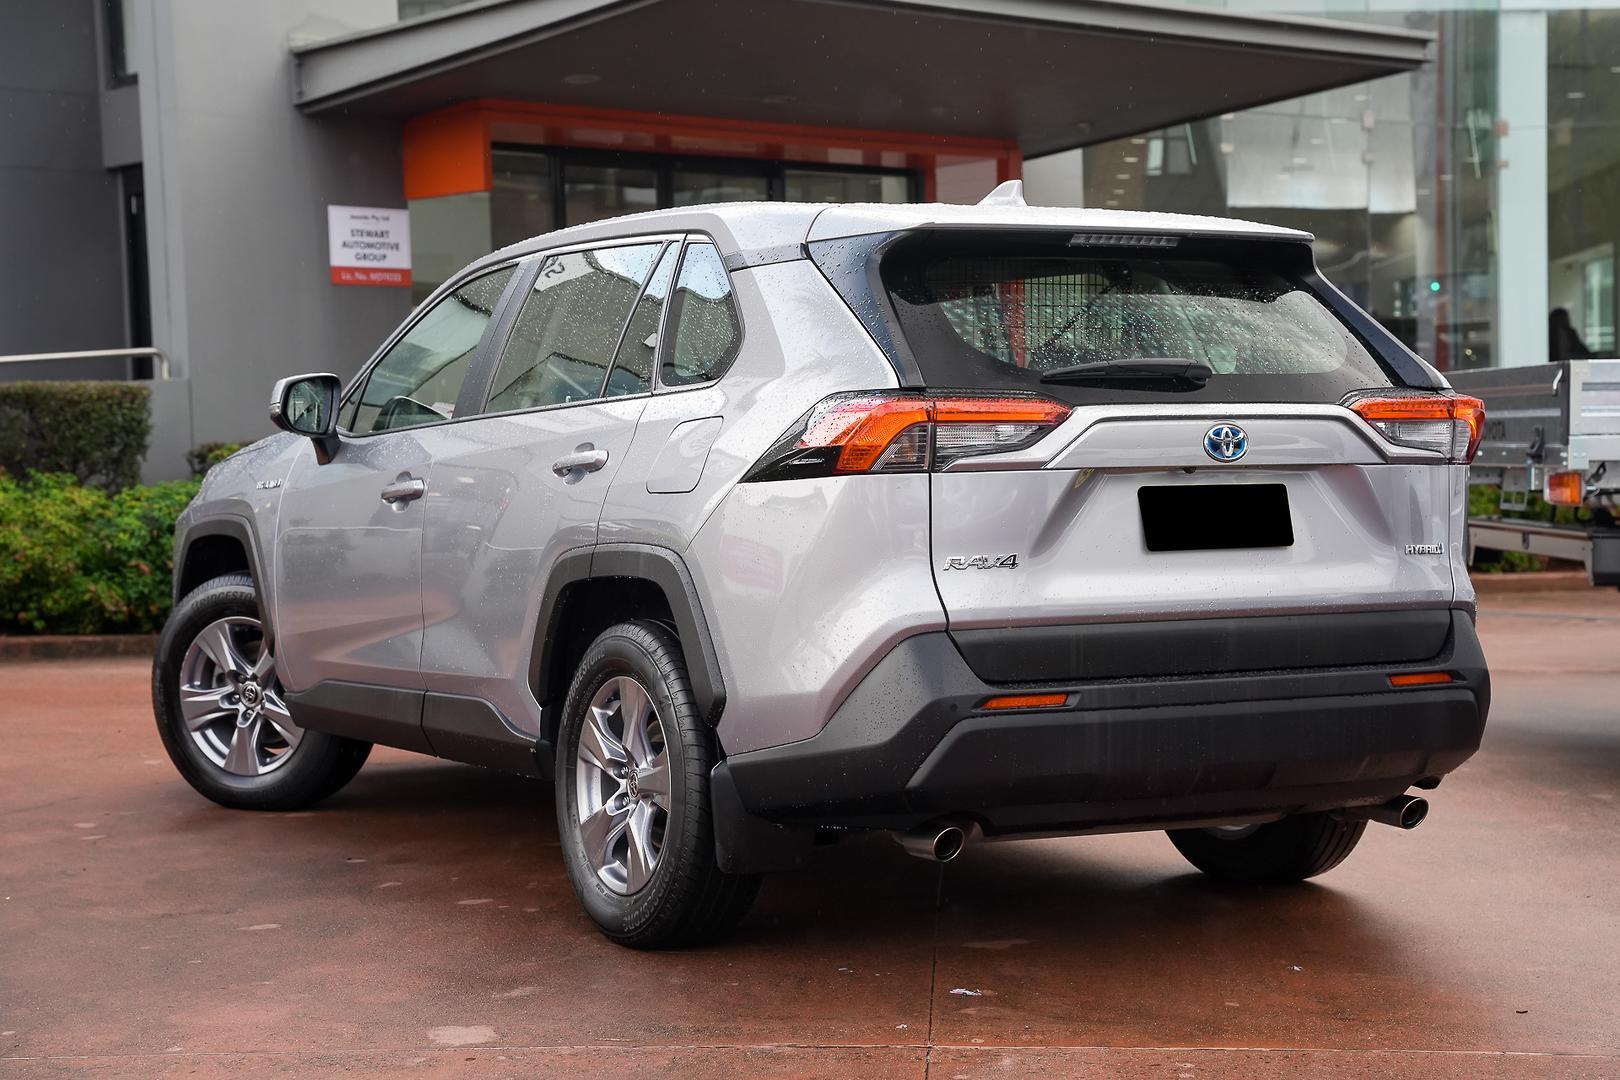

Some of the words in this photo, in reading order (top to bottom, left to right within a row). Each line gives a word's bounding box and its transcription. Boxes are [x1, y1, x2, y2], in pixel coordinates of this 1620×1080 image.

[350, 228, 391, 239] STEWART
[341, 240, 400, 252] AUTOMOTIVE
[354, 252, 387, 262] GROUP
[1405, 542, 1445, 555] HYBRID
[943, 553, 1019, 571] RAV4
[190, 589, 256, 609] BRIDGESTO
